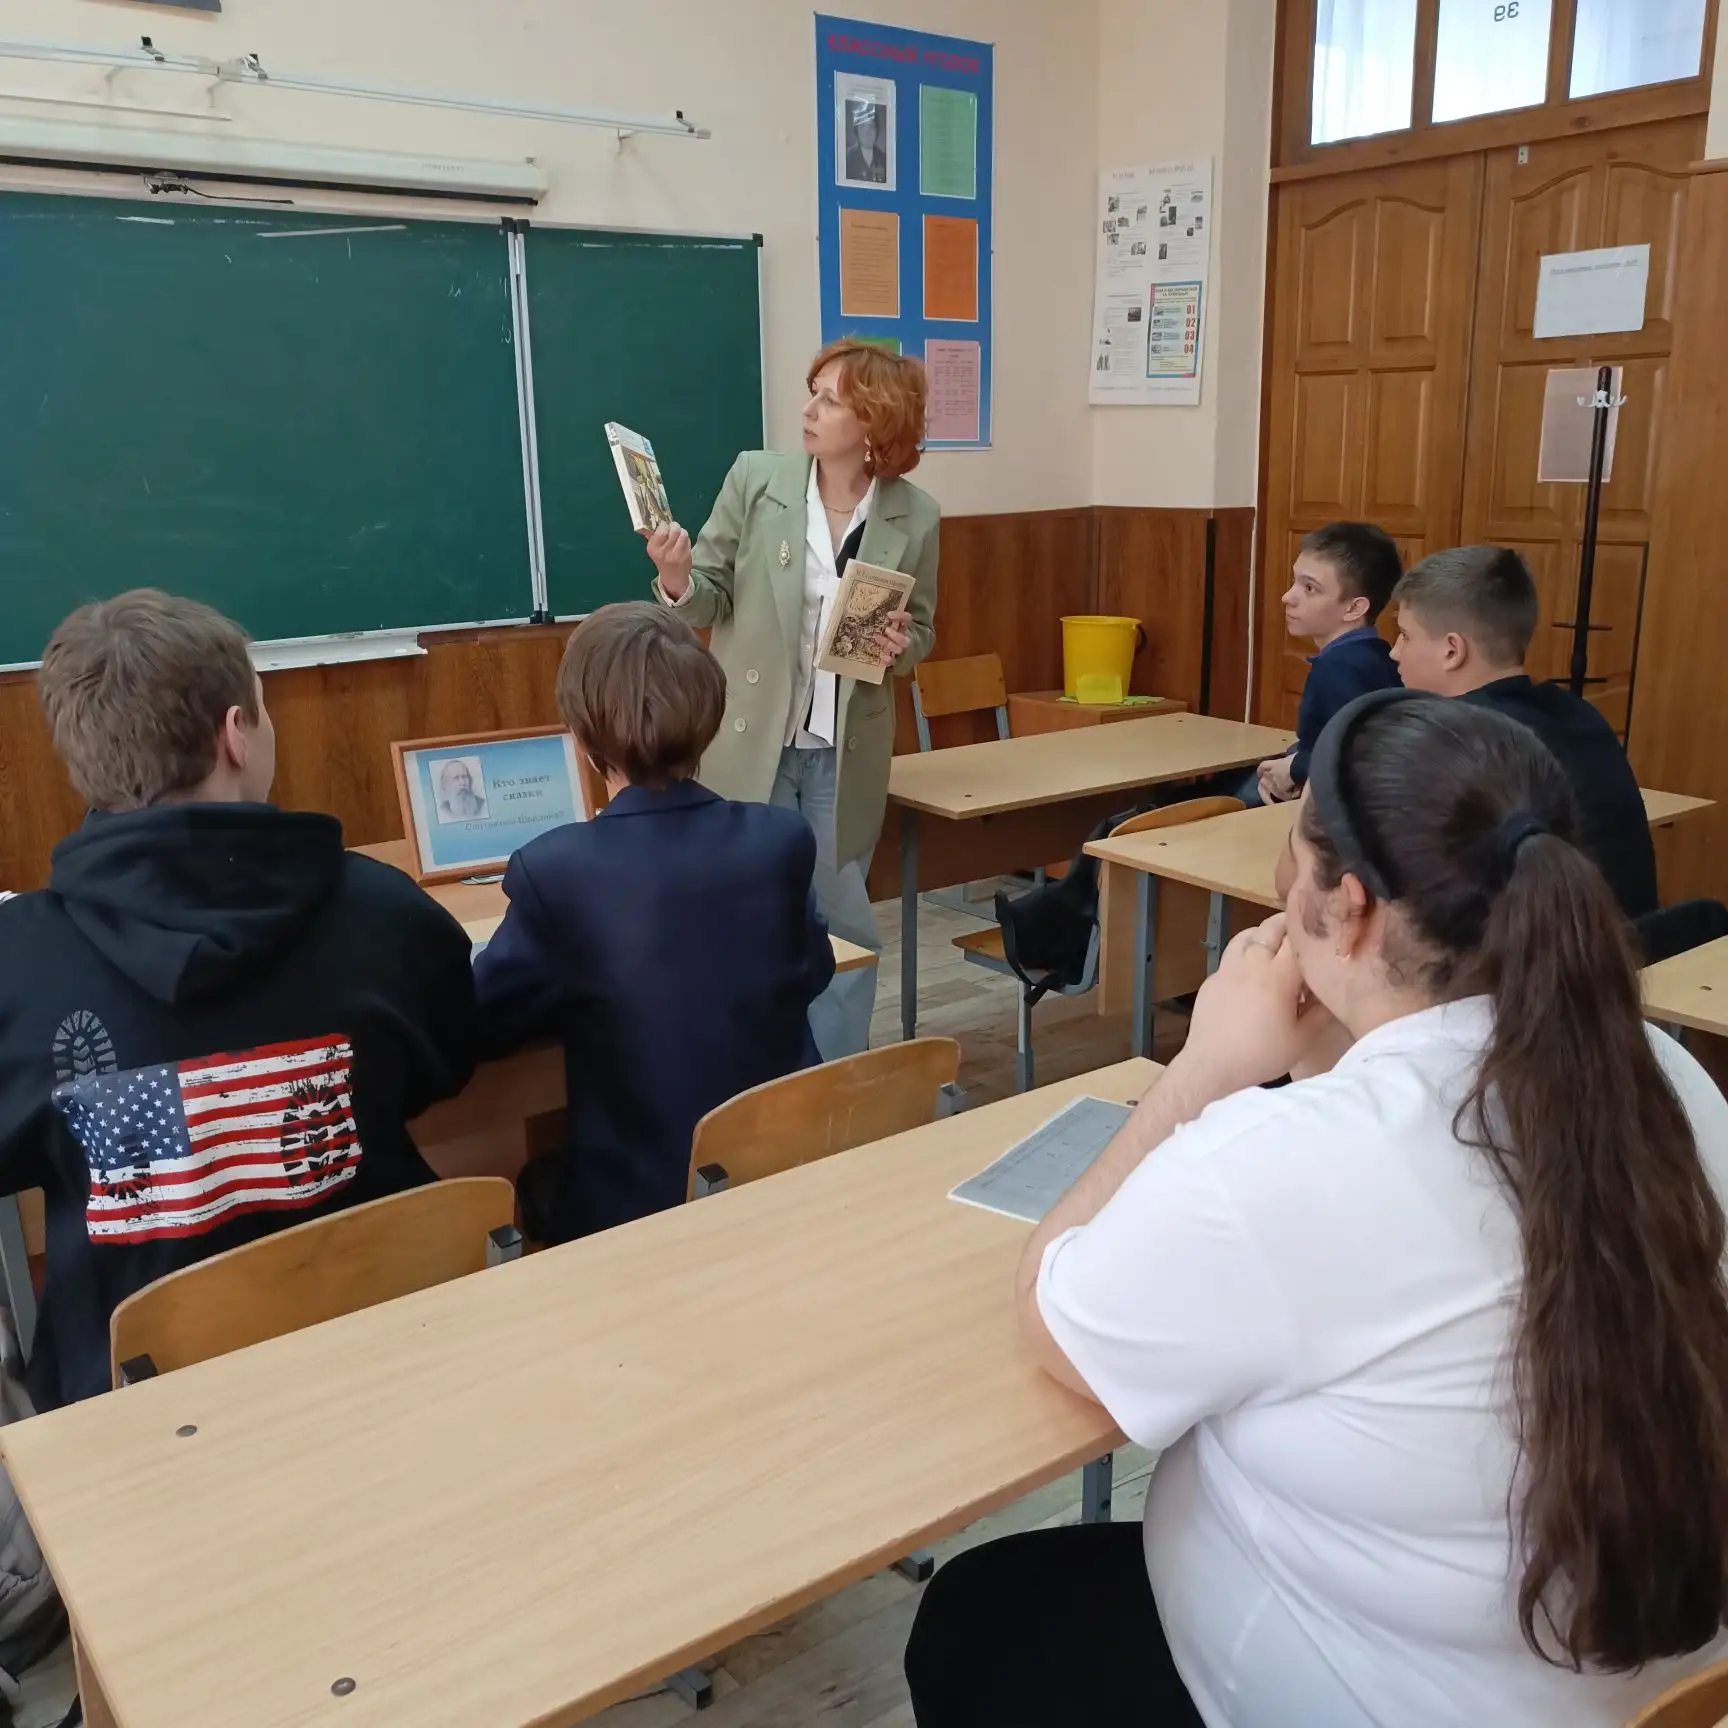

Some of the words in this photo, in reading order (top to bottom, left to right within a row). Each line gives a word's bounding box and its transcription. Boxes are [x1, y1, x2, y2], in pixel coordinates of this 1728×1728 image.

[1186, 304, 1196, 315] 01
[1185, 318, 1196, 328] 02
[1184, 330, 1195, 341] 03
[1183, 344, 1194, 354] 04
[492, 779, 515, 789] Кто
[519, 775, 551, 785] знает
[502, 790, 543, 801] сказки
